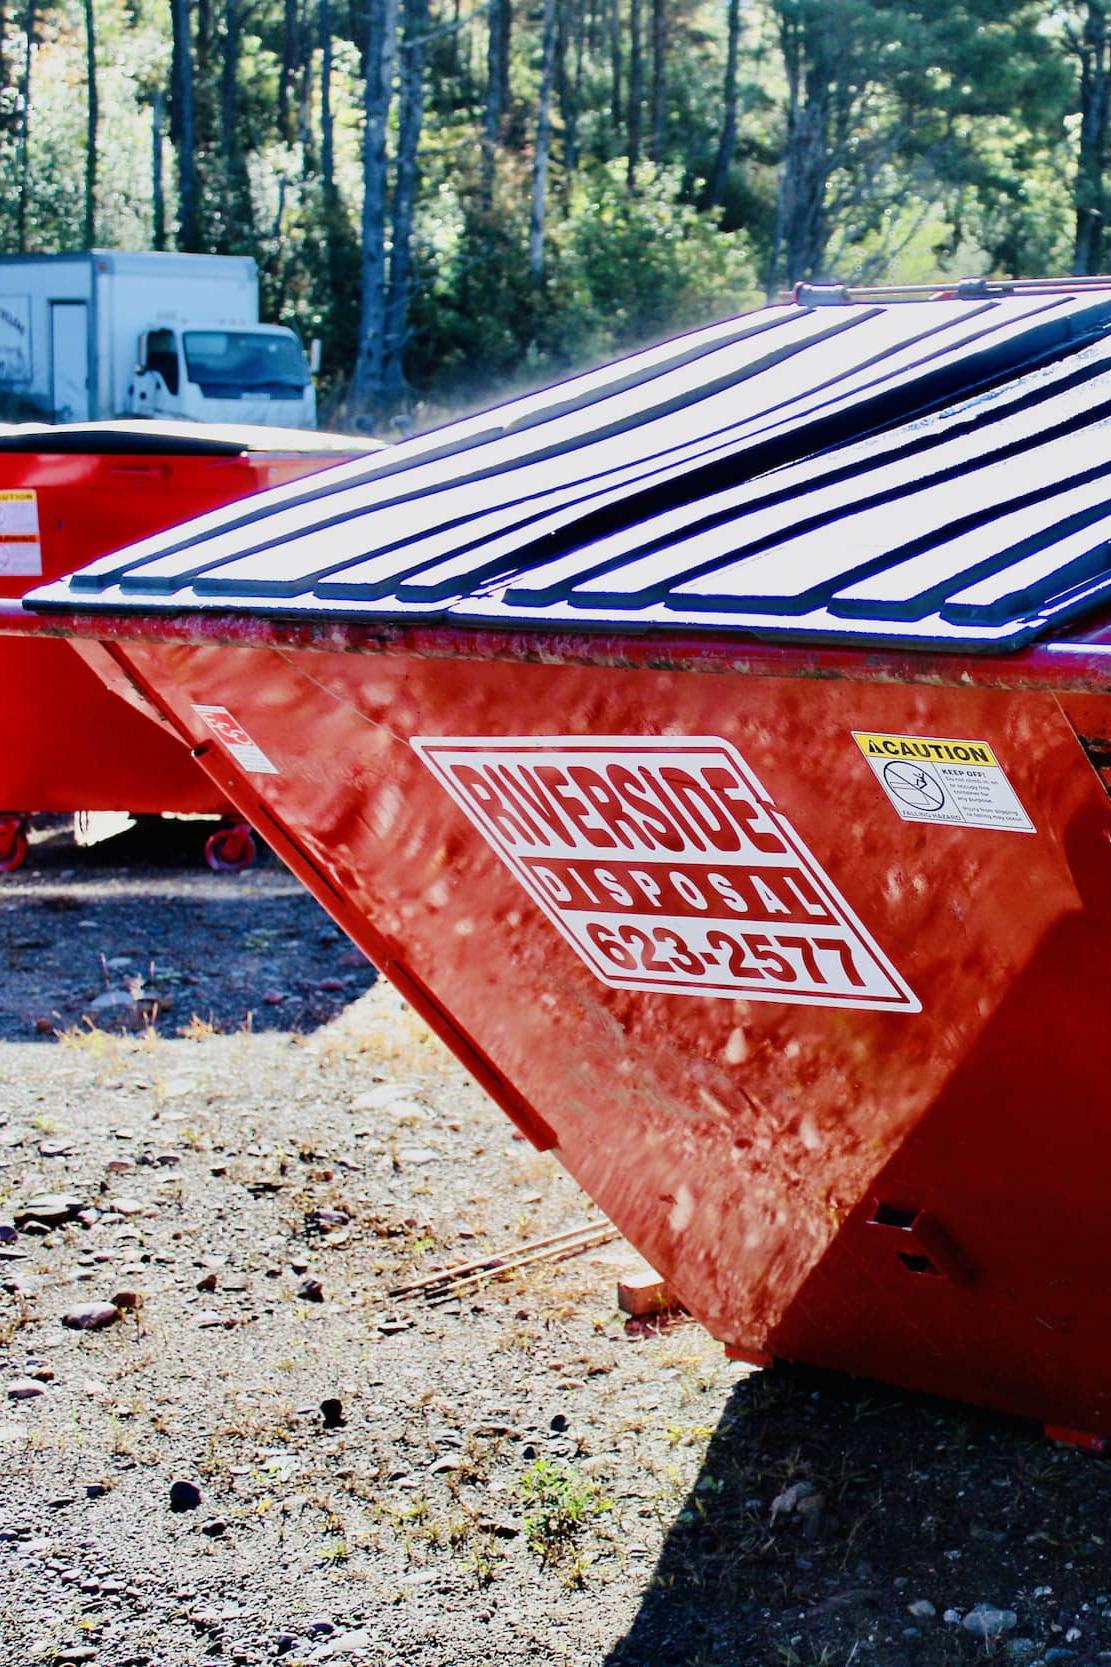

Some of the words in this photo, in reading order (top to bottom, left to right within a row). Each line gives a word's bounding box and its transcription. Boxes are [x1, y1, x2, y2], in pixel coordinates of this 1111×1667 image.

[882, 740, 989, 762] CAUTION
[942, 768, 965, 776] KEEP
[450, 763, 787, 854] RIVERSIDE
[531, 865, 823, 915] DISPOSAL
[586, 922, 867, 987] 623-2577
